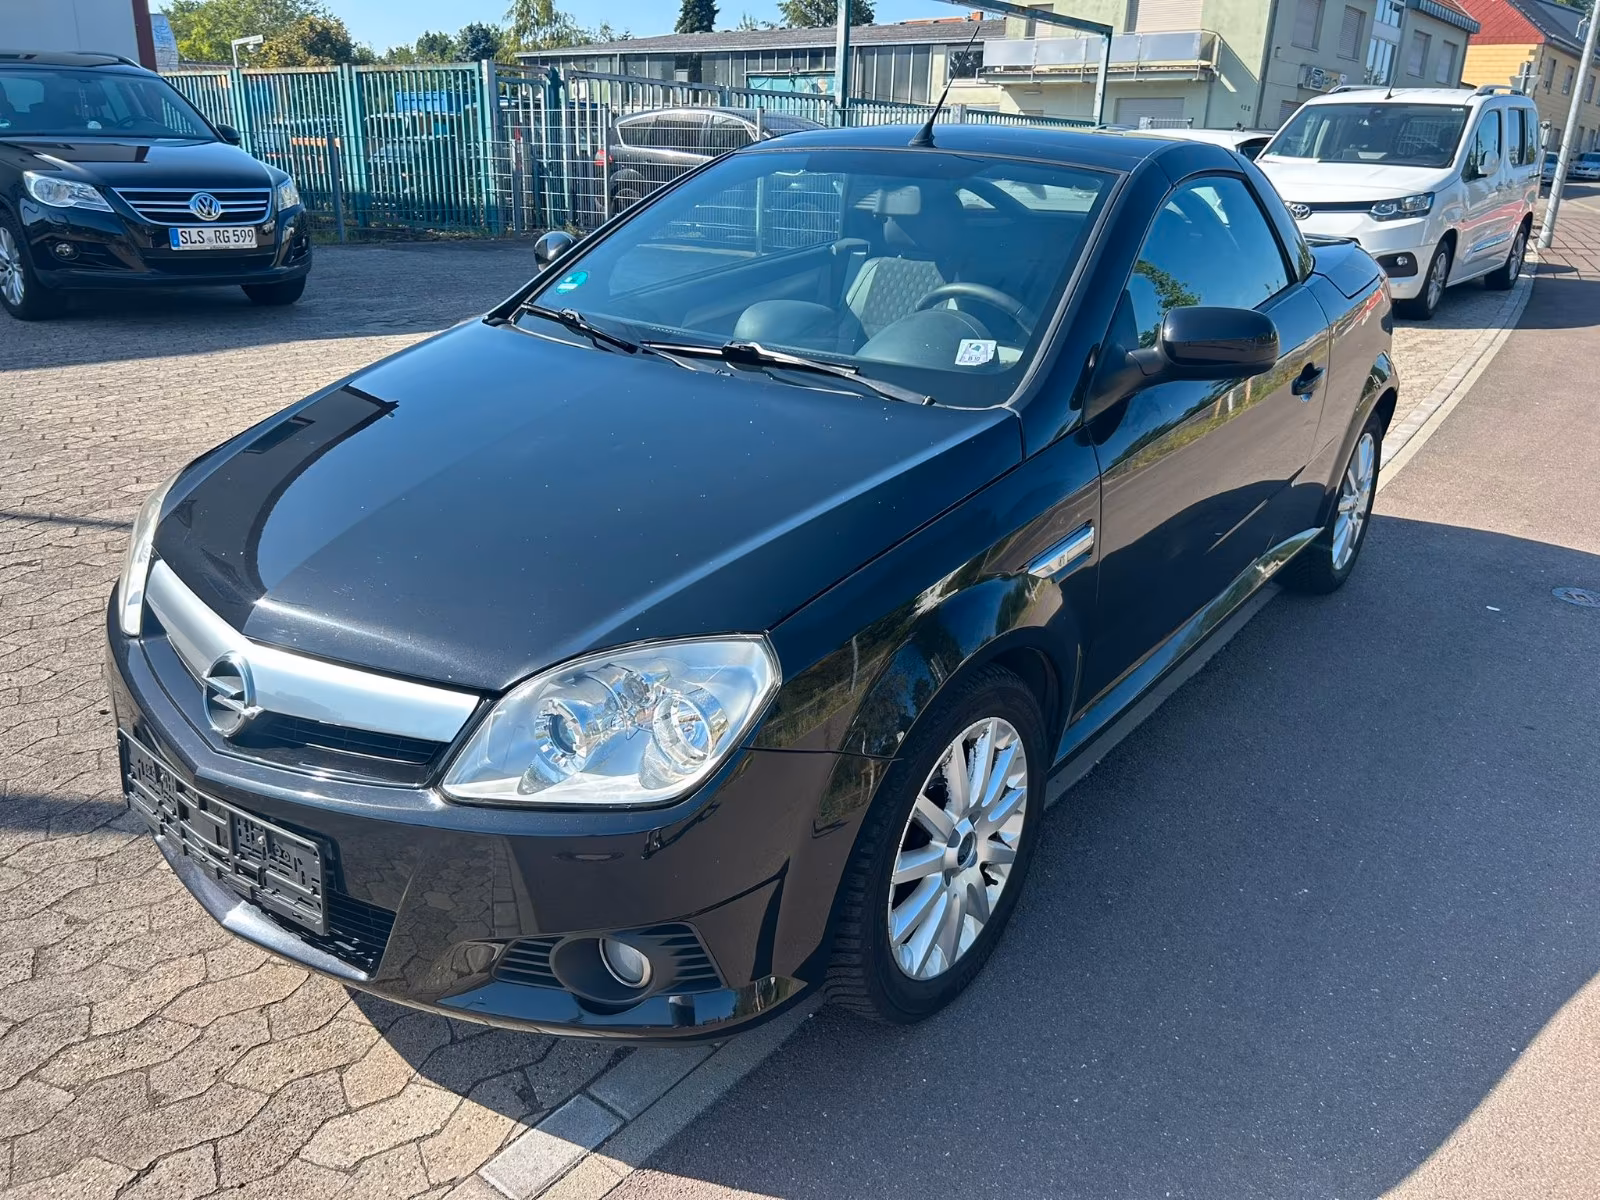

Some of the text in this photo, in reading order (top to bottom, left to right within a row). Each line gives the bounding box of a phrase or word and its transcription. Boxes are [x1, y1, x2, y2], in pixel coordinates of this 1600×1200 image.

[193, 194, 220, 219] VW
[180, 229, 254, 244] SLS RG 599
